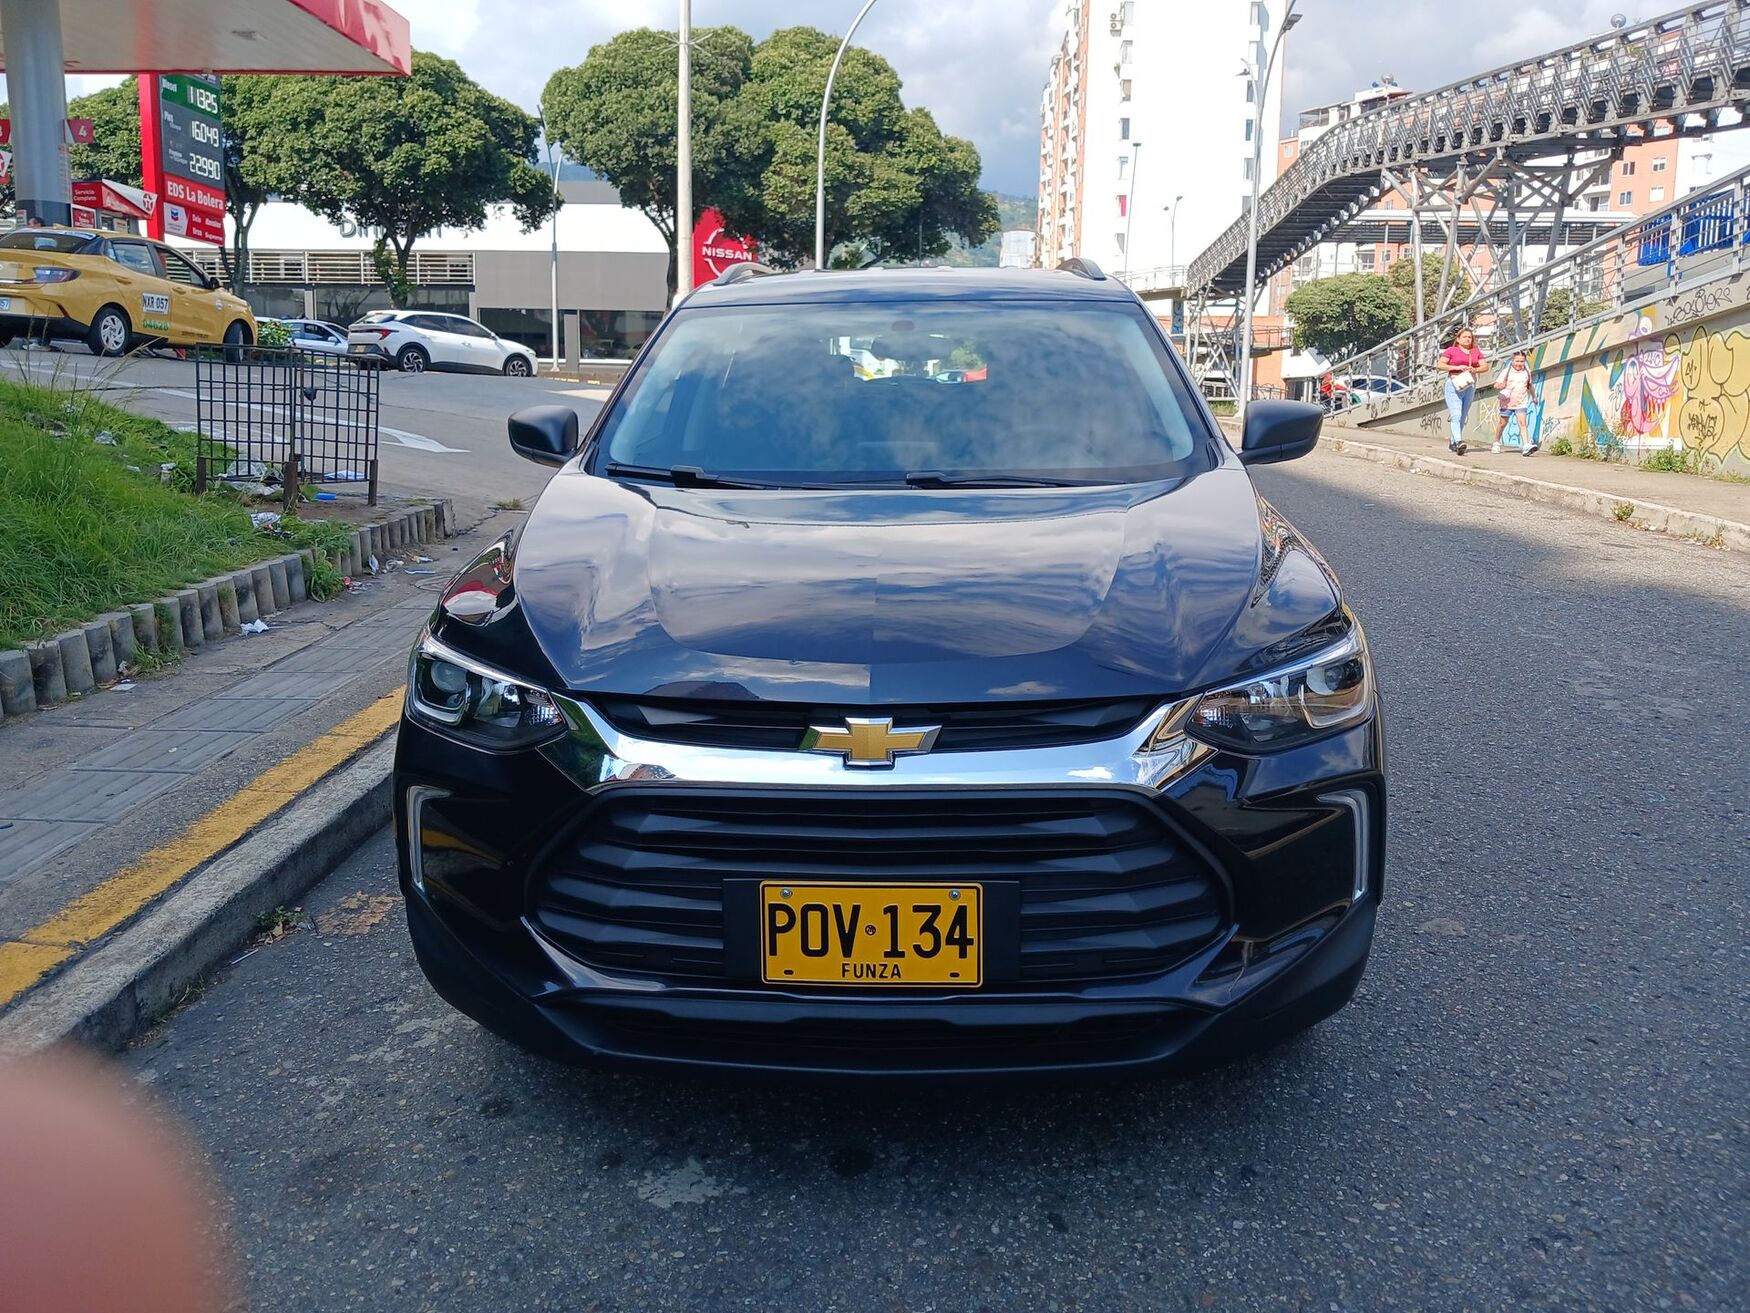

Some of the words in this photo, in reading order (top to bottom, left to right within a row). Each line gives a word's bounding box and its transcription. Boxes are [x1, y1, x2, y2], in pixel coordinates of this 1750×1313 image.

[79, 125, 87, 137] 4
[189, 152, 220, 180] 22990
[167, 180, 185, 199] EDS
[186, 186, 196, 202] La
[197, 189, 224, 210] Bolera
[701, 246, 753, 260] NISSAN
[142, 294, 155, 309] NXR
[156, 296, 168, 311] 057
[768, 903, 861, 958] POV
[883, 904, 974, 959] 134
[841, 963, 902, 979] FUNZA
